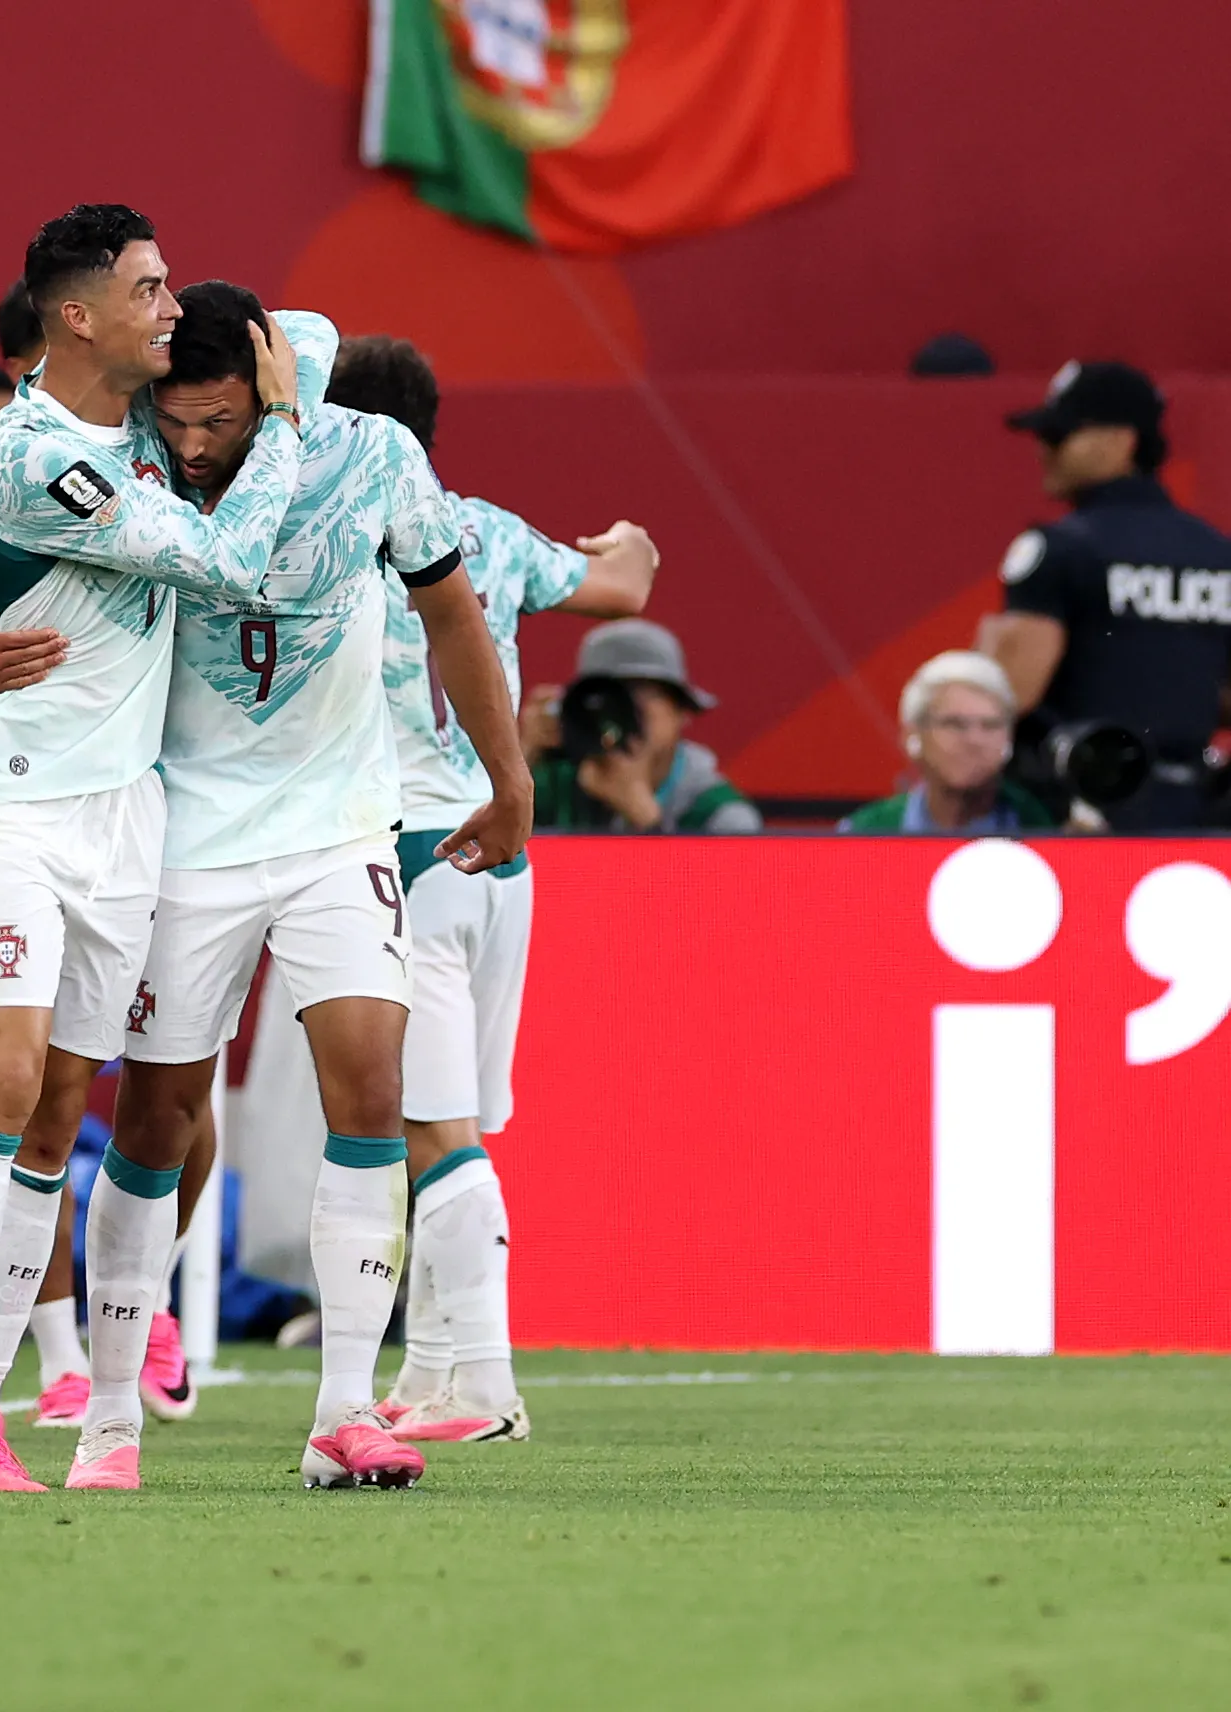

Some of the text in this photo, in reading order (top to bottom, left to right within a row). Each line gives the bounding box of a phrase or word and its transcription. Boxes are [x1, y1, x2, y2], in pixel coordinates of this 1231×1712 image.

[240, 620, 277, 702] 9
[365, 863, 403, 938] 9
[102, 1302, 141, 1320] F.P.F.
